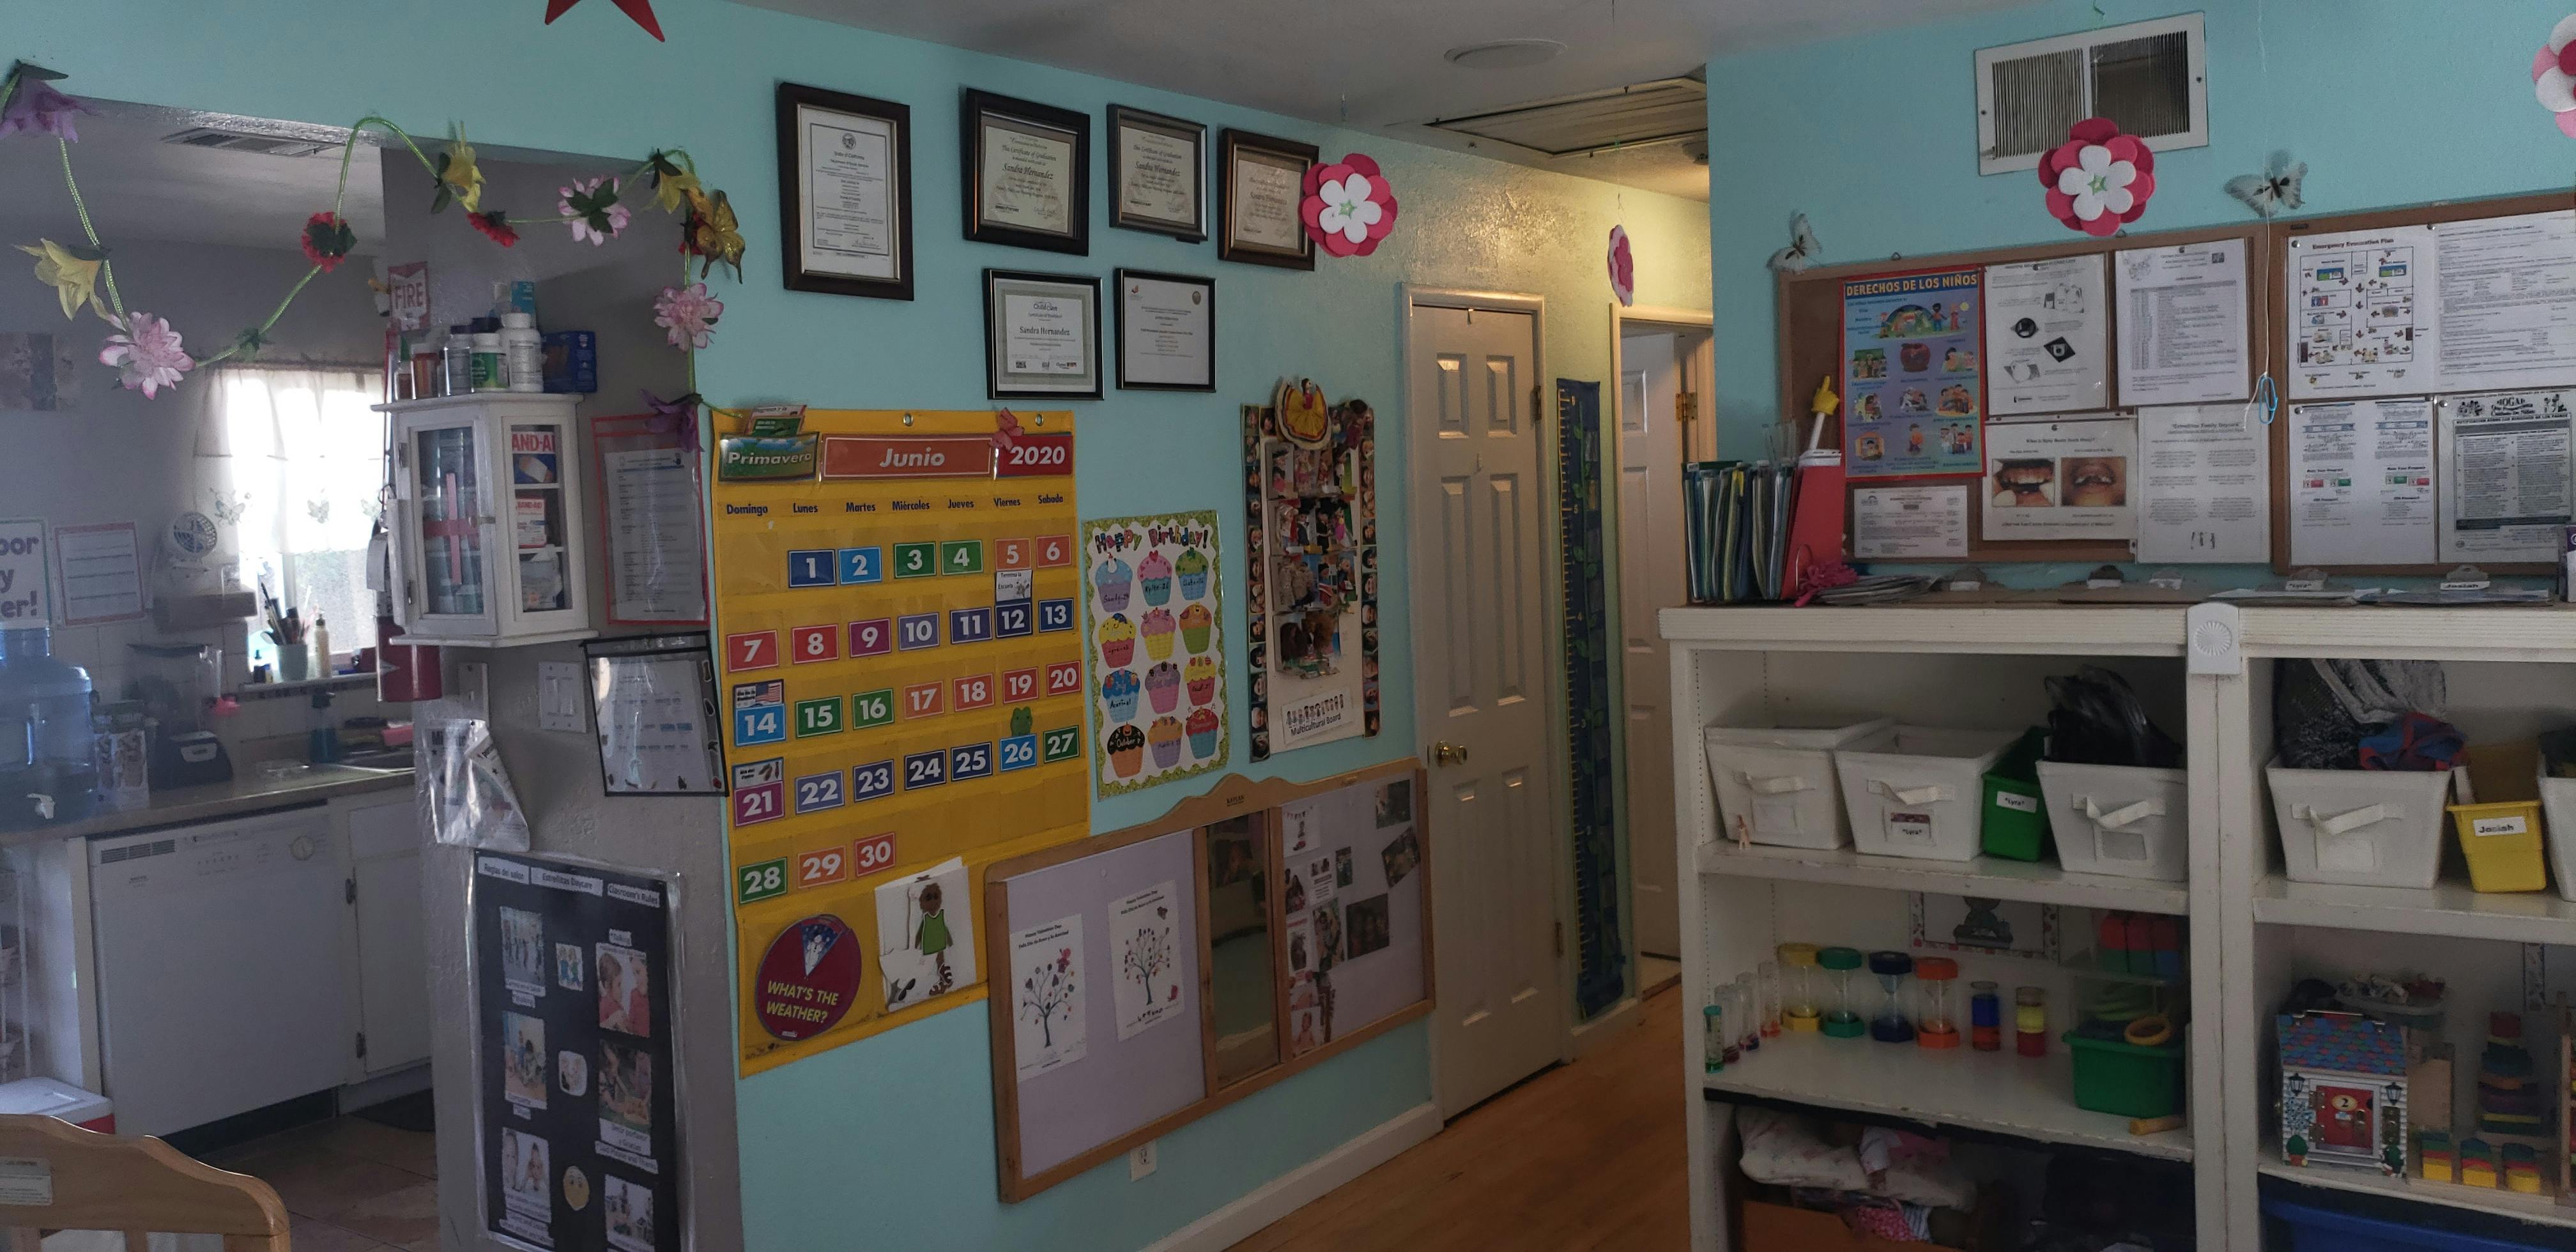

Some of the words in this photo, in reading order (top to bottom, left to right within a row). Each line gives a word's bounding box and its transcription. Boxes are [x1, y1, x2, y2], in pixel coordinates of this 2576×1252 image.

[1002, 162, 1022, 174] Sandra
[1023, 167, 1054, 180] Hernandez
[1135, 160, 1153, 172] Sandra
[1154, 163, 1181, 178] Hernandez
[1846, 282, 1900, 296] DERECHOS
[1903, 280, 1917, 291] DE
[1919, 277, 1940, 289] LOS
[1942, 273, 1977, 287] NIÑOS
[395, 282, 424, 309] FIRE
[1020, 326, 1039, 335] Sandra
[1040, 326, 1070, 336] Hernandez
[728, 451, 812, 466] Primavera
[879, 447, 945, 468] Junio
[1009, 446, 1066, 466] 2020
[726, 503, 769, 516] Domingo
[792, 503, 818, 514] Lunes
[846, 501, 876, 513] Martes
[892, 499, 930, 512] Miércoles
[947, 498, 975, 510] Jueves
[993, 496, 1021, 508] Viernes
[1574, 503, 1578, 514] 5
[1094, 529, 1142, 554] Happy
[1148, 525, 1209, 549] Birthday!
[907, 549, 923, 570] 3
[954, 547, 970, 567] 4
[1006, 545, 1020, 565] 5
[1046, 542, 1061, 561] 6
[806, 558, 816, 579] 1
[852, 554, 868, 576] 2
[960, 615, 981, 636] 11
[1001, 609, 1025, 629] 12
[1045, 605, 1068, 625] 13
[861, 627, 878, 648] 9
[905, 620, 932, 641] 10
[744, 639, 762, 662] 7
[807, 633, 824, 655] 8
[1009, 675, 1032, 694] 19
[1050, 668, 1078, 689] 20
[911, 689, 938, 711] 17
[961, 682, 986, 703] 18
[805, 705, 833, 728] 15
[861, 698, 886, 720] 16
[745, 712, 778, 737] 14
[1291, 719, 1326, 737] Multicultural
[1326, 712, 1342, 724] Board
[1004, 743, 1033, 763] 26
[1047, 734, 1075, 754] 27
[1117, 738, 1136, 747] October
[909, 758, 941, 781] 24
[956, 751, 986, 772] 25
[800, 779, 839, 805] 22
[858, 772, 889, 793] 23
[743, 790, 772, 818] 21
[2478, 824, 2514, 834] Josiah
[860, 842, 891, 867] 30
[802, 853, 841, 880] 29
[744, 867, 781, 894] 28
[767, 980, 813, 1000] WHAT'S
[818, 989, 839, 1005] THE
[767, 1001, 828, 1023] WEATHER?
[2341, 1098, 2349, 1108] 2
